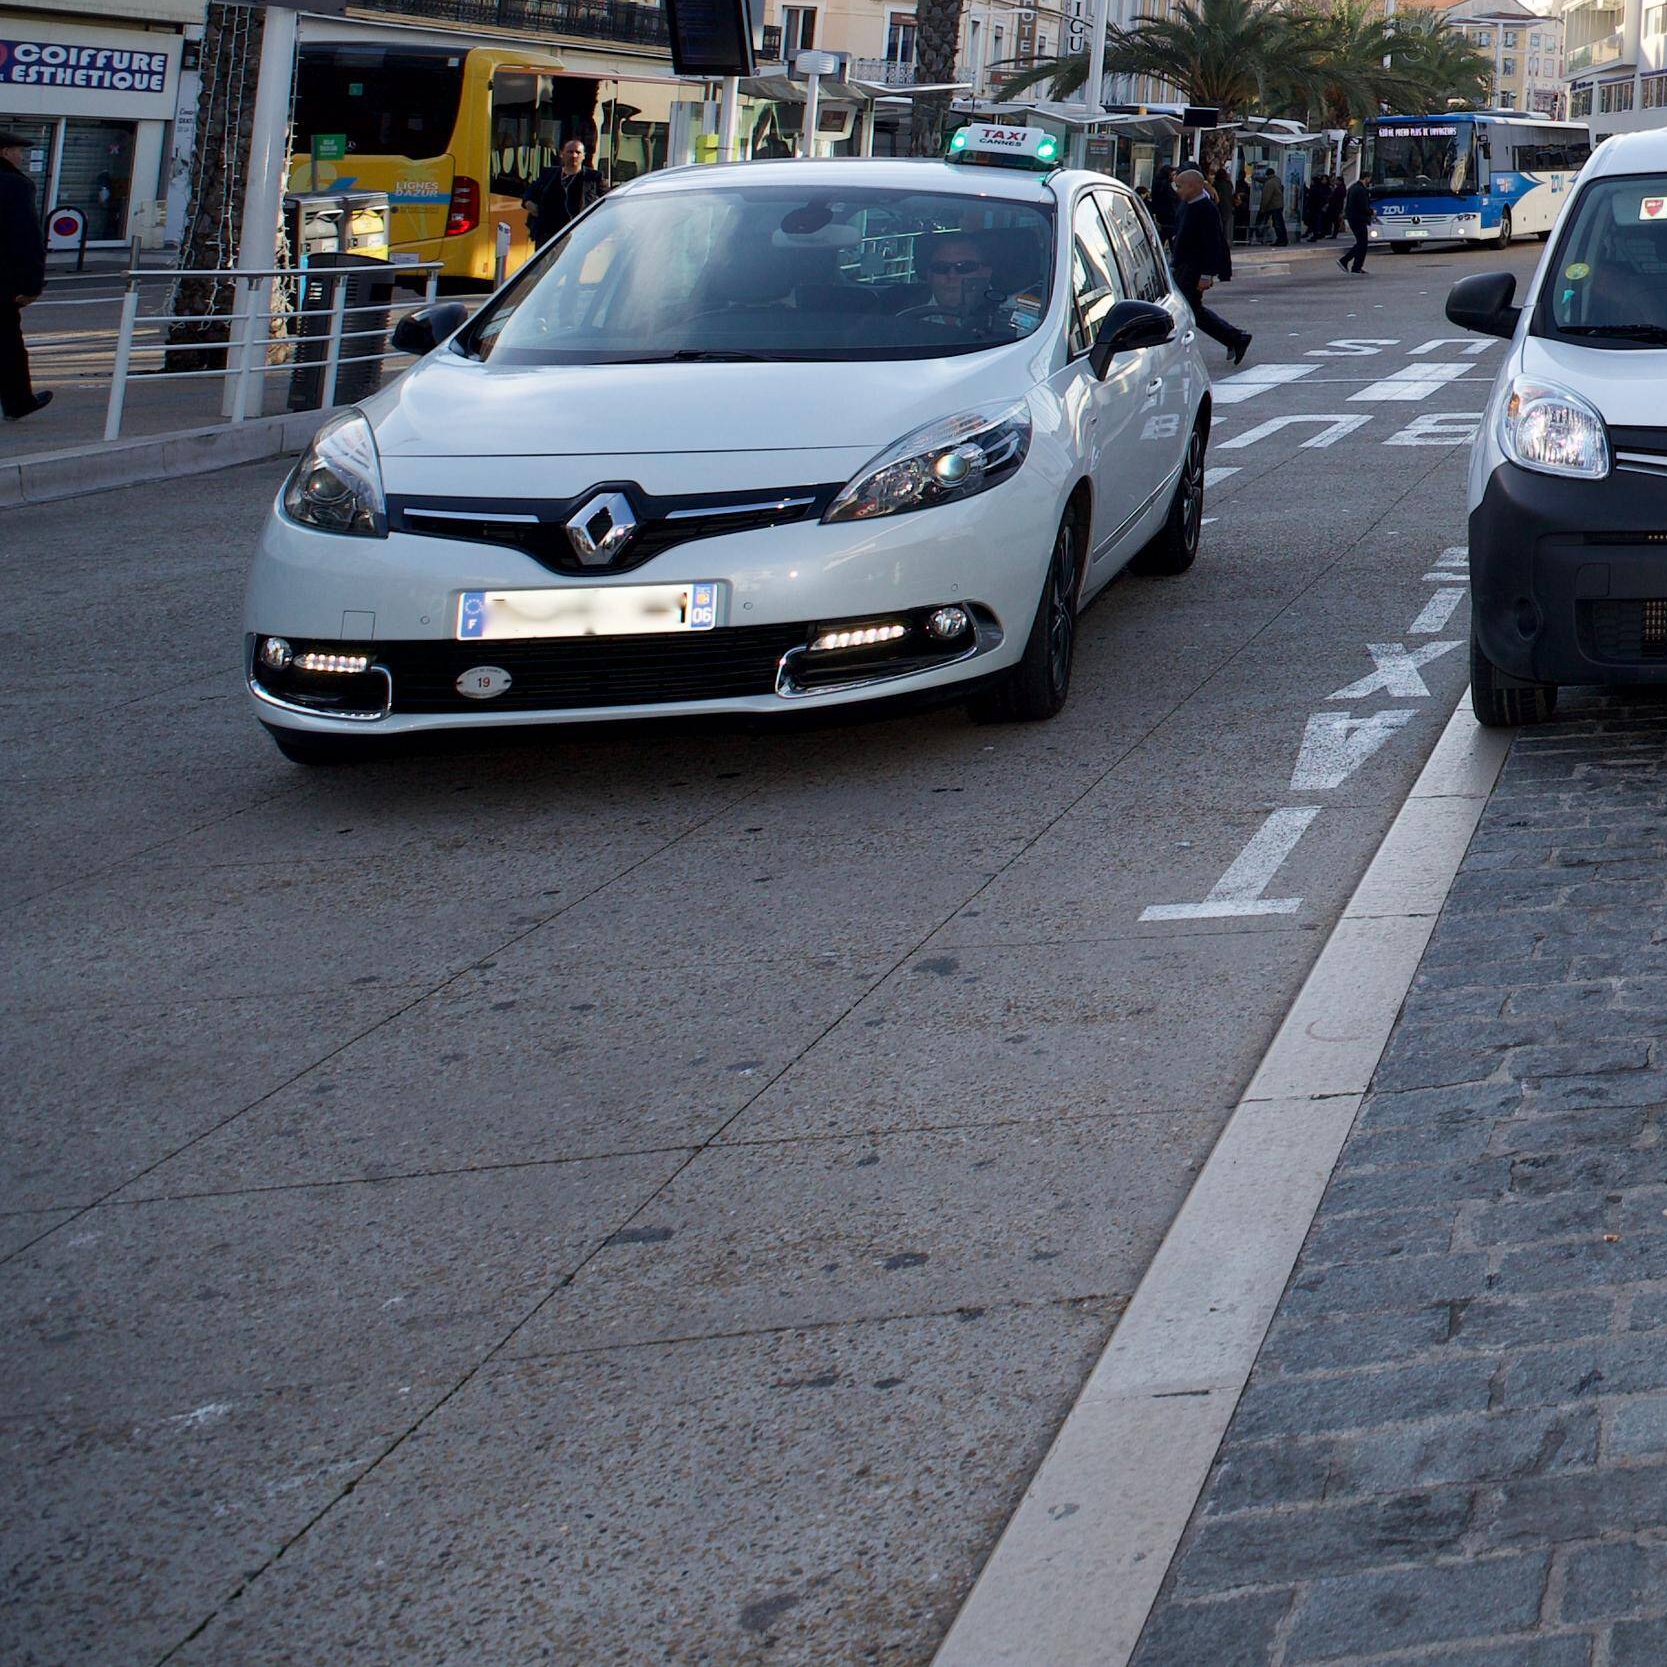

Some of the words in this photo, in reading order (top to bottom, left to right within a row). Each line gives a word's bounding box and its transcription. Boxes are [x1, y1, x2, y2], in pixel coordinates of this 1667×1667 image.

[14, 43, 167, 72] COIFFURE
[11, 65, 163, 91] ESTHETIQUE
[981, 129, 1027, 141] TAXI
[979, 138, 1022, 147] CANNES
[395, 181, 438, 190] LIGNES
[693, 608, 712, 623] 06
[467, 619, 477, 630] F
[477, 677, 491, 688] 19
[1138, 587, 1467, 922] TAXI
